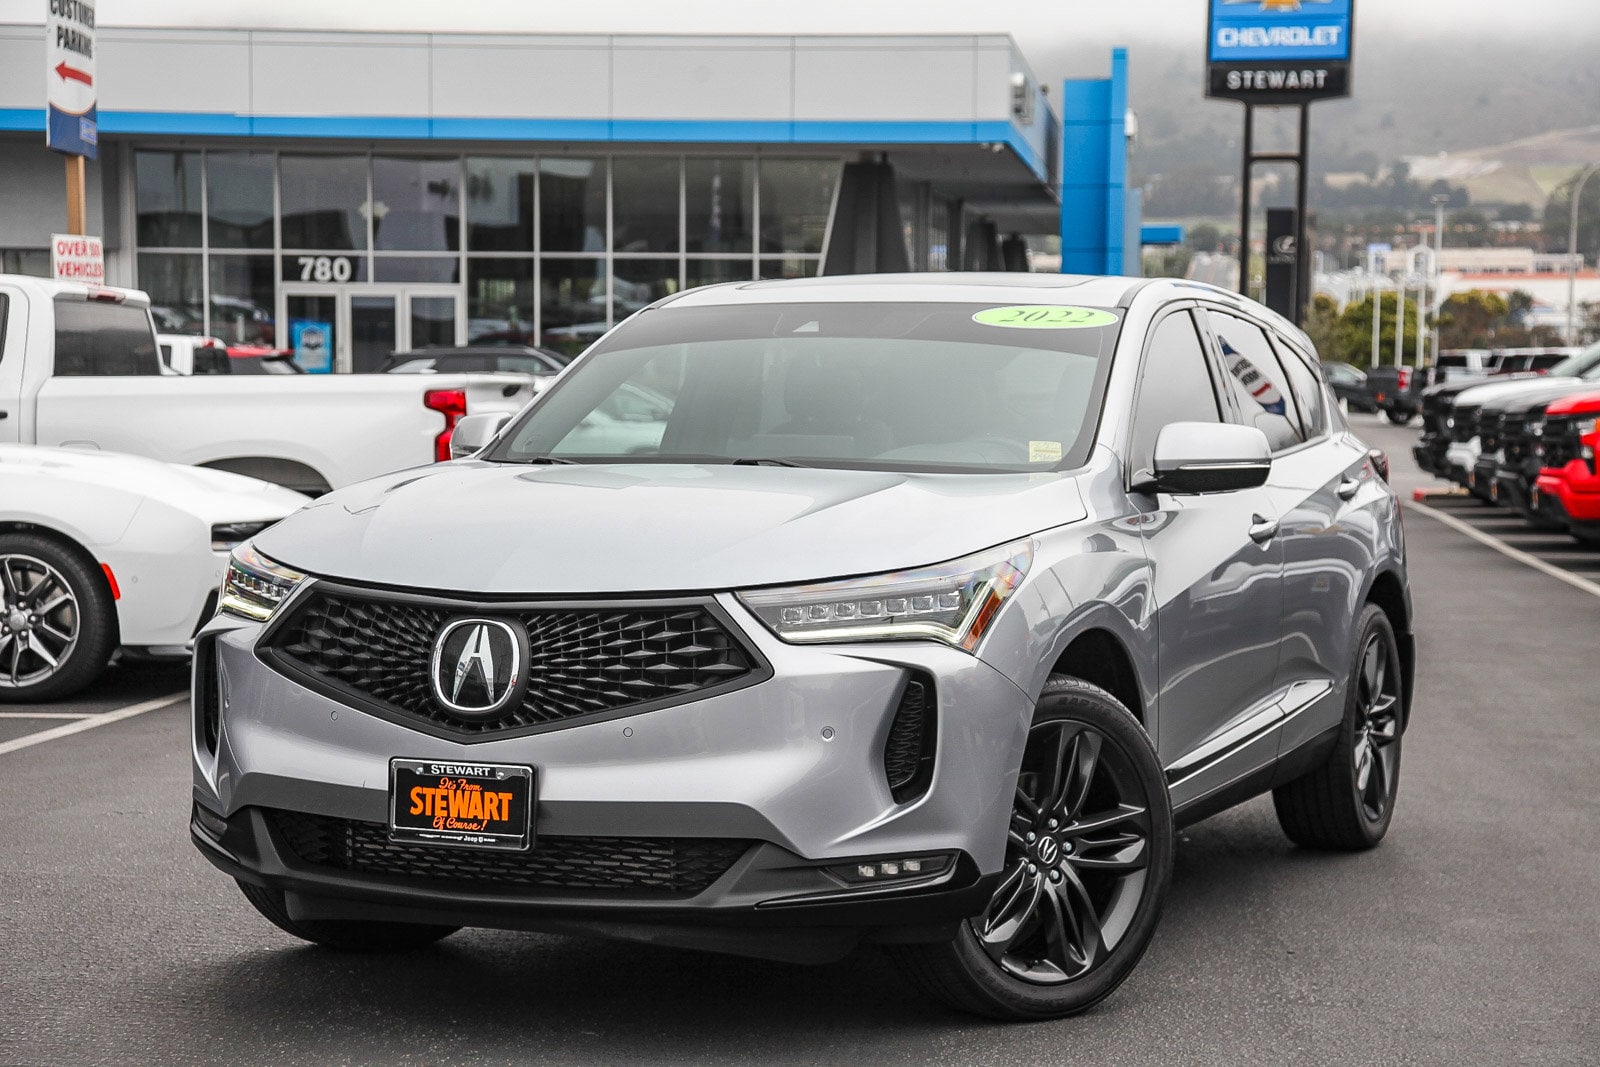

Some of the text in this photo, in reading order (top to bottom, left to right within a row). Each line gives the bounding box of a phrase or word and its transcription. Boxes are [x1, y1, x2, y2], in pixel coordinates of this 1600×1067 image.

[1217, 26, 1341, 47] CHEVROLET
[1227, 70, 1328, 90] STEWART
[57, 240, 87, 257] OVER
[298, 256, 352, 283] 780
[998, 309, 1095, 323] 2022
[431, 764, 491, 776] STEWART
[438, 777, 483, 792] It's From
[410, 786, 513, 821] STEWART
[433, 816, 445, 830] Of
